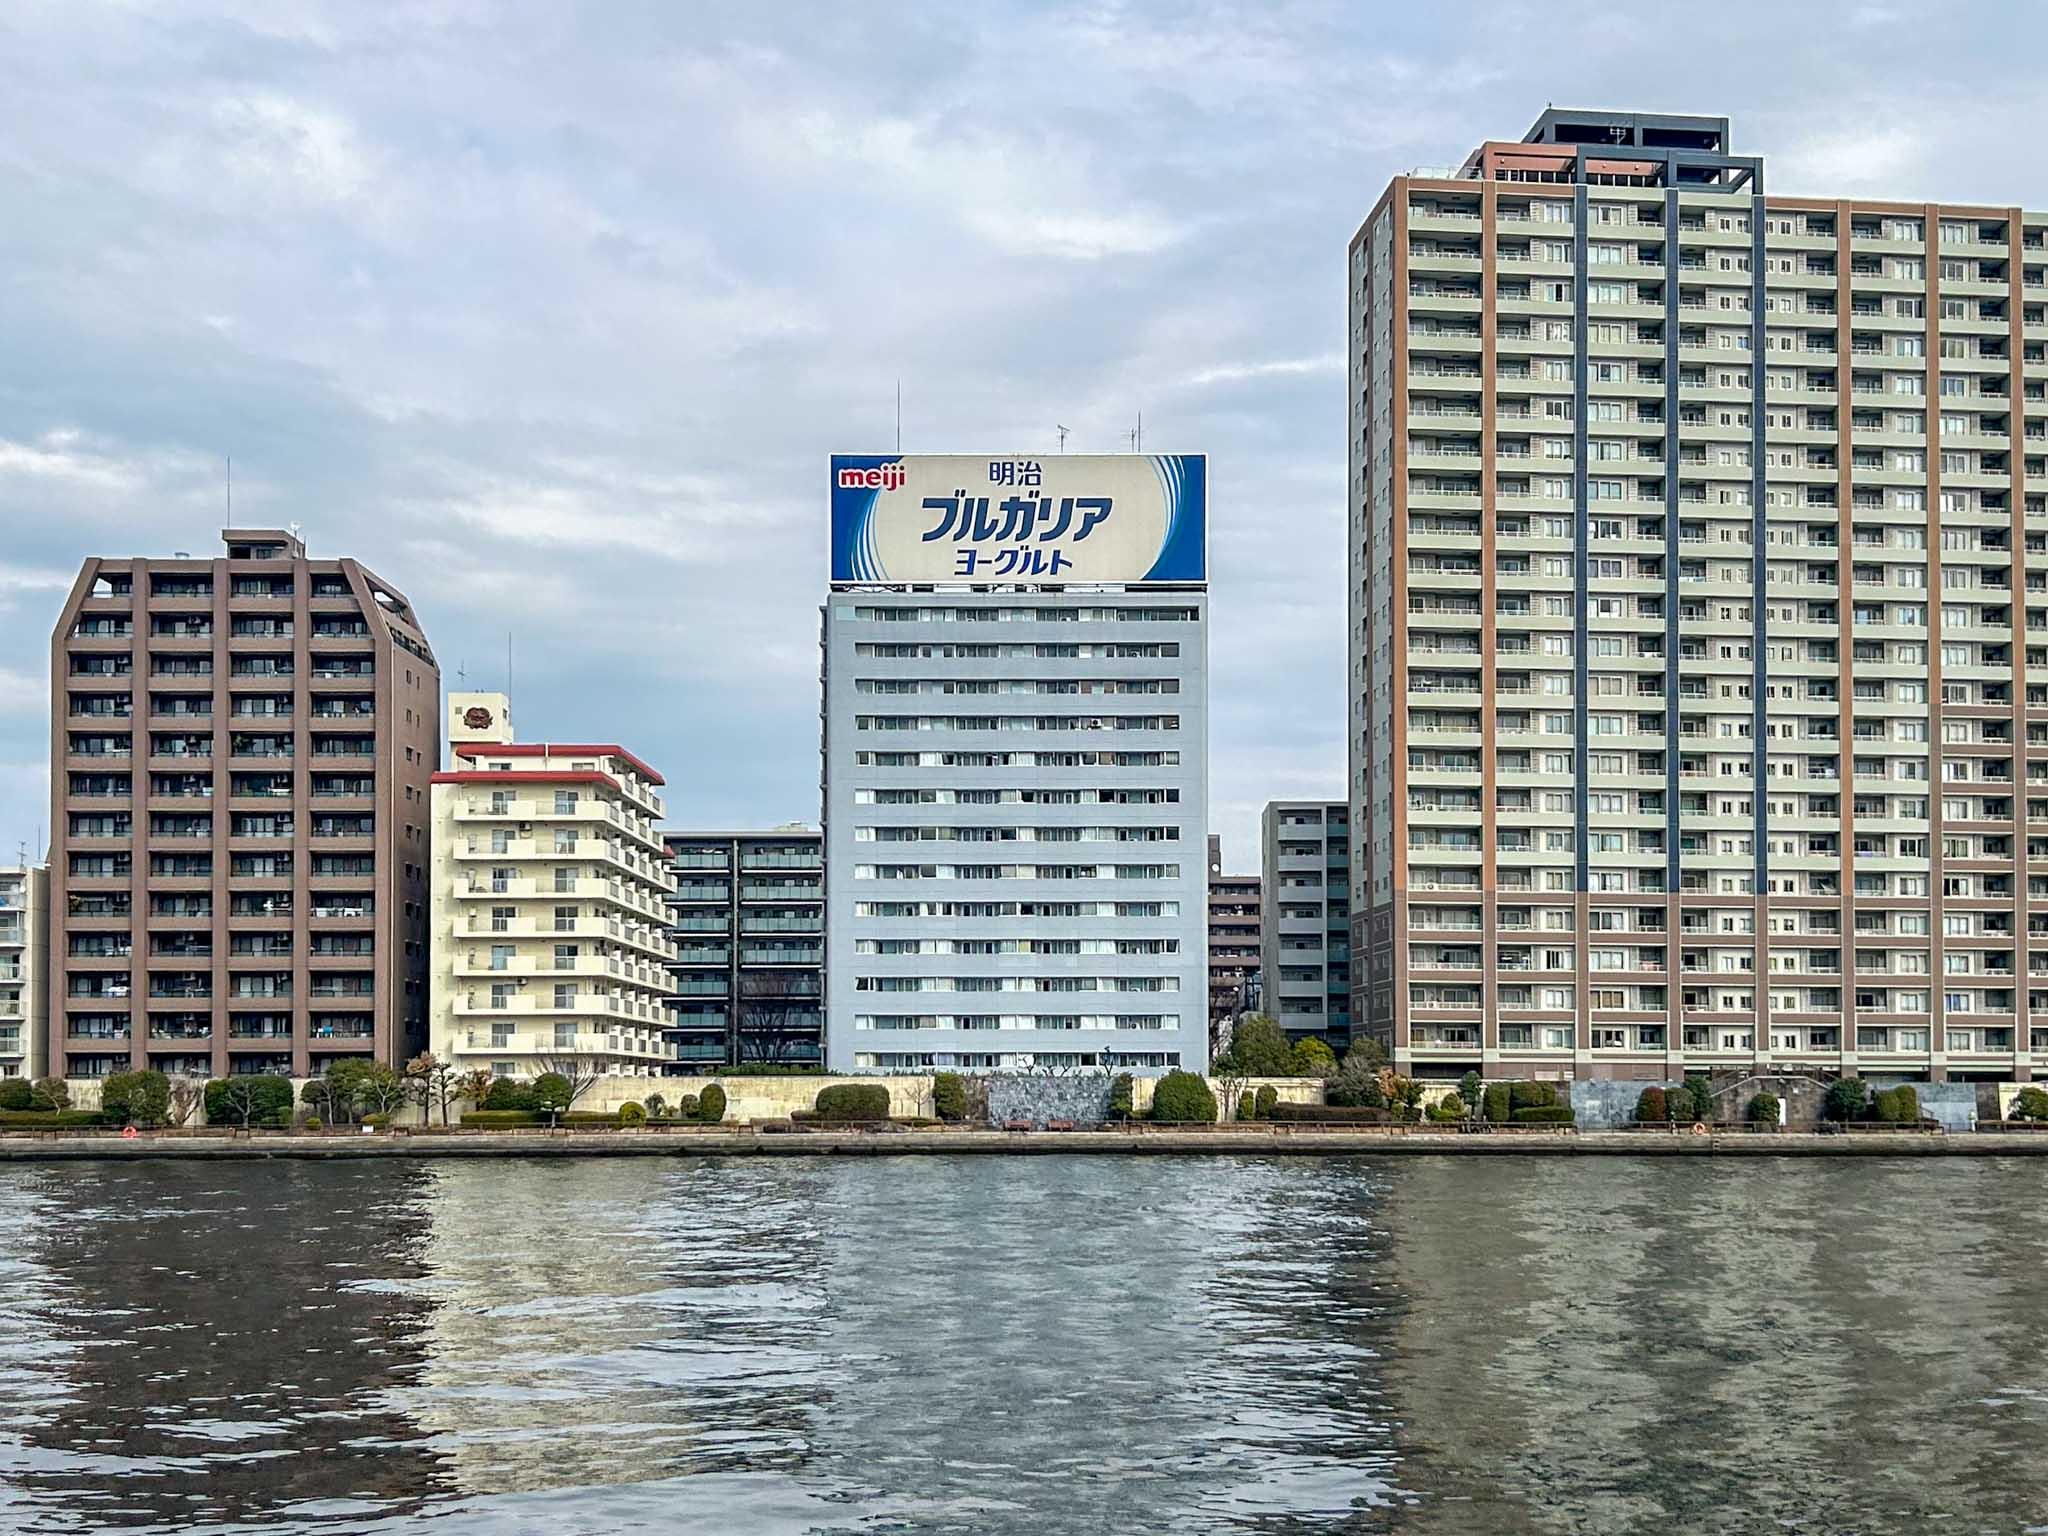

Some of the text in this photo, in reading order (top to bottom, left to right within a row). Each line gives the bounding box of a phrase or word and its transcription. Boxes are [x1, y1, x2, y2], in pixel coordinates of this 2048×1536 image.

[840, 464, 905, 491] meiji
[988, 462, 1042, 486] 明治
[921, 489, 1113, 543] ブルガリア
[954, 545, 1073, 576] ヨーグルト
